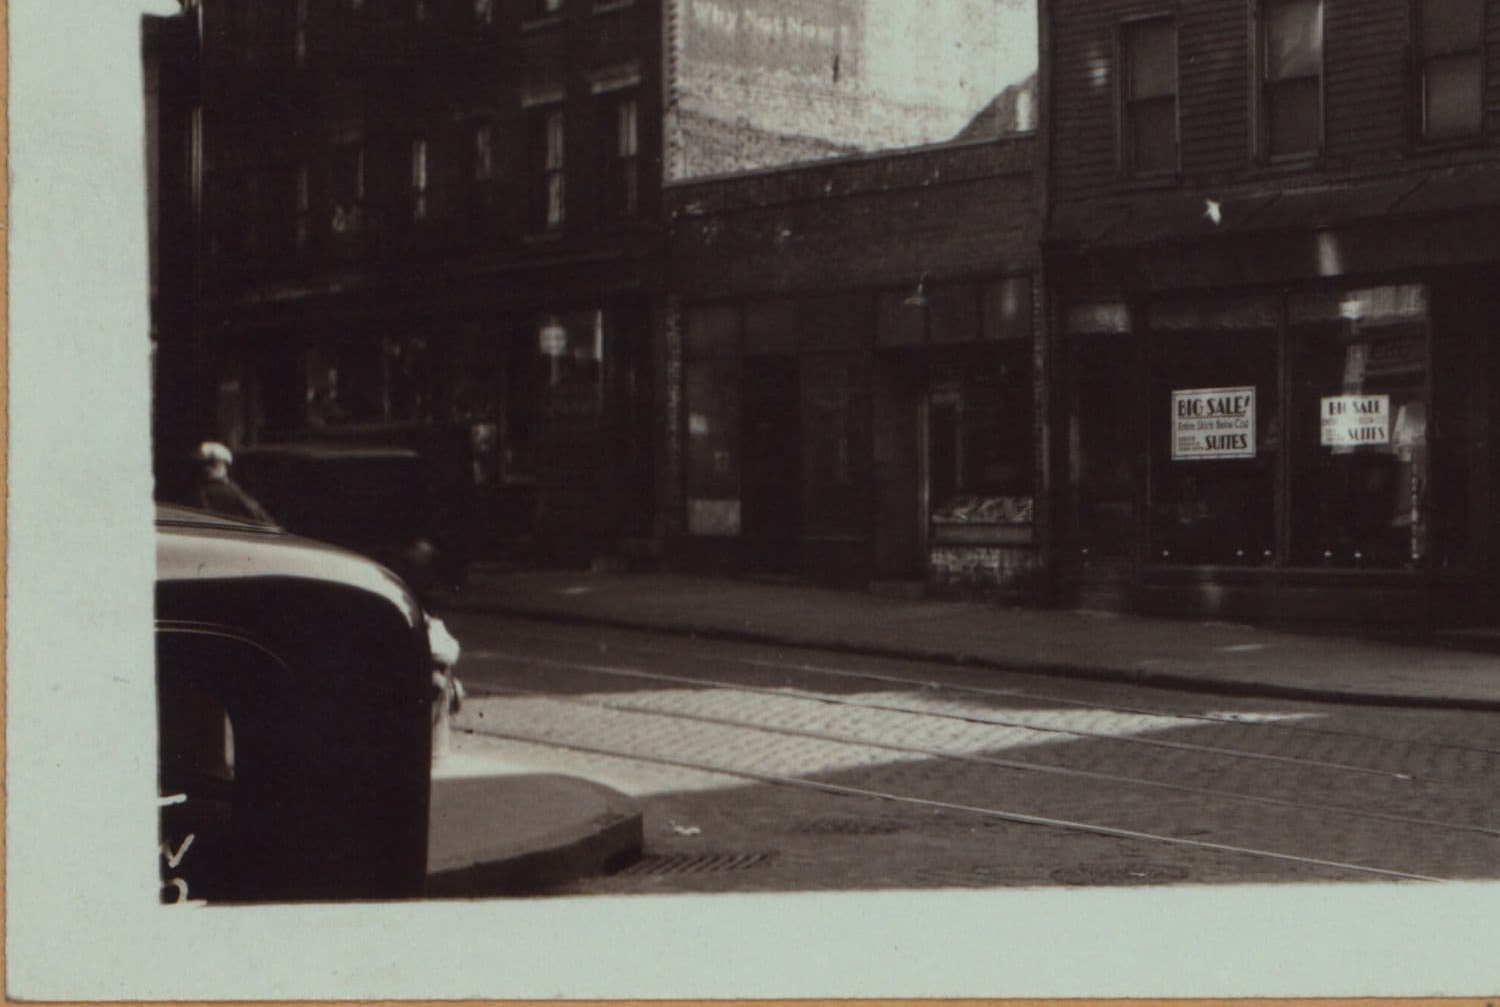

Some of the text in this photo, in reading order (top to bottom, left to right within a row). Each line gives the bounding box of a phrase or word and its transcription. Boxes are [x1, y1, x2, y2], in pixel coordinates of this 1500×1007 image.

[1178, 395, 1250, 417] BIG SALE!
[1204, 434, 1248, 451] SUITES
